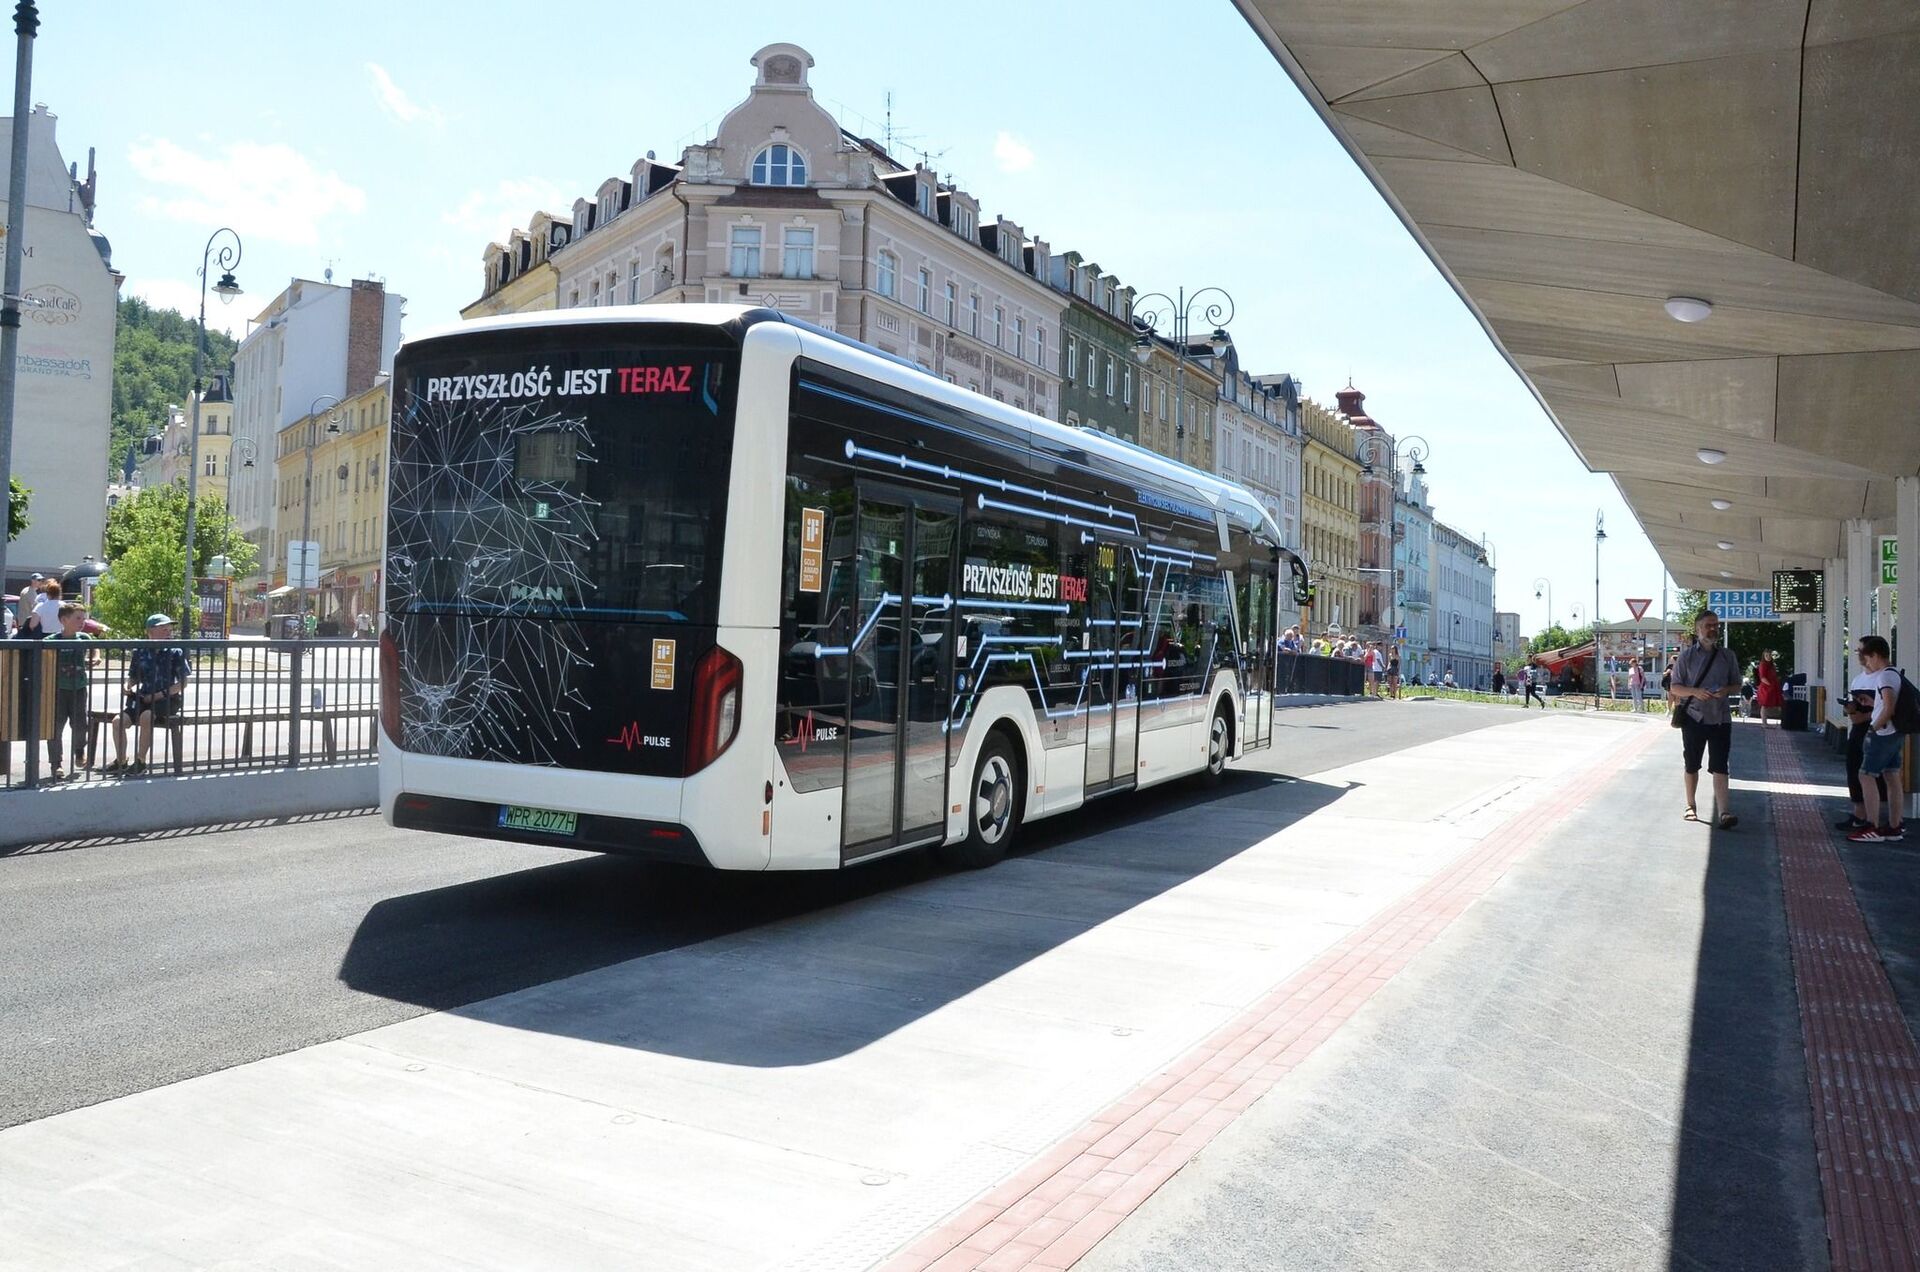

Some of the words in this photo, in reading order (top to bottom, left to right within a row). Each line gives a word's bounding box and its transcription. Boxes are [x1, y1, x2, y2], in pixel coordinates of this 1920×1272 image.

[427, 365, 552, 401] PRZYSZŁOŚĆ
[557, 369, 612, 396] JEST
[617, 366, 692, 393] TERAZ
[1884, 542, 1898, 554] 10
[1884, 565, 1898, 578] 10
[963, 564, 1033, 597] PRZYSZŁOŚĆ
[1034, 572, 1058, 599] JEST
[1060, 575, 1088, 601] TERAZ
[511, 586, 563, 600] MAN
[1715, 592, 1721, 600] 2
[1733, 592, 1739, 600] 3
[1750, 592, 1757, 600] 4
[1730, 607, 1742, 616] 12
[1747, 607, 1759, 616] 19
[815, 727, 837, 742] PULSE
[643, 735, 671, 748] PULSE
[507, 807, 531, 825] WPR
[533, 811, 576, 831] 2077H
